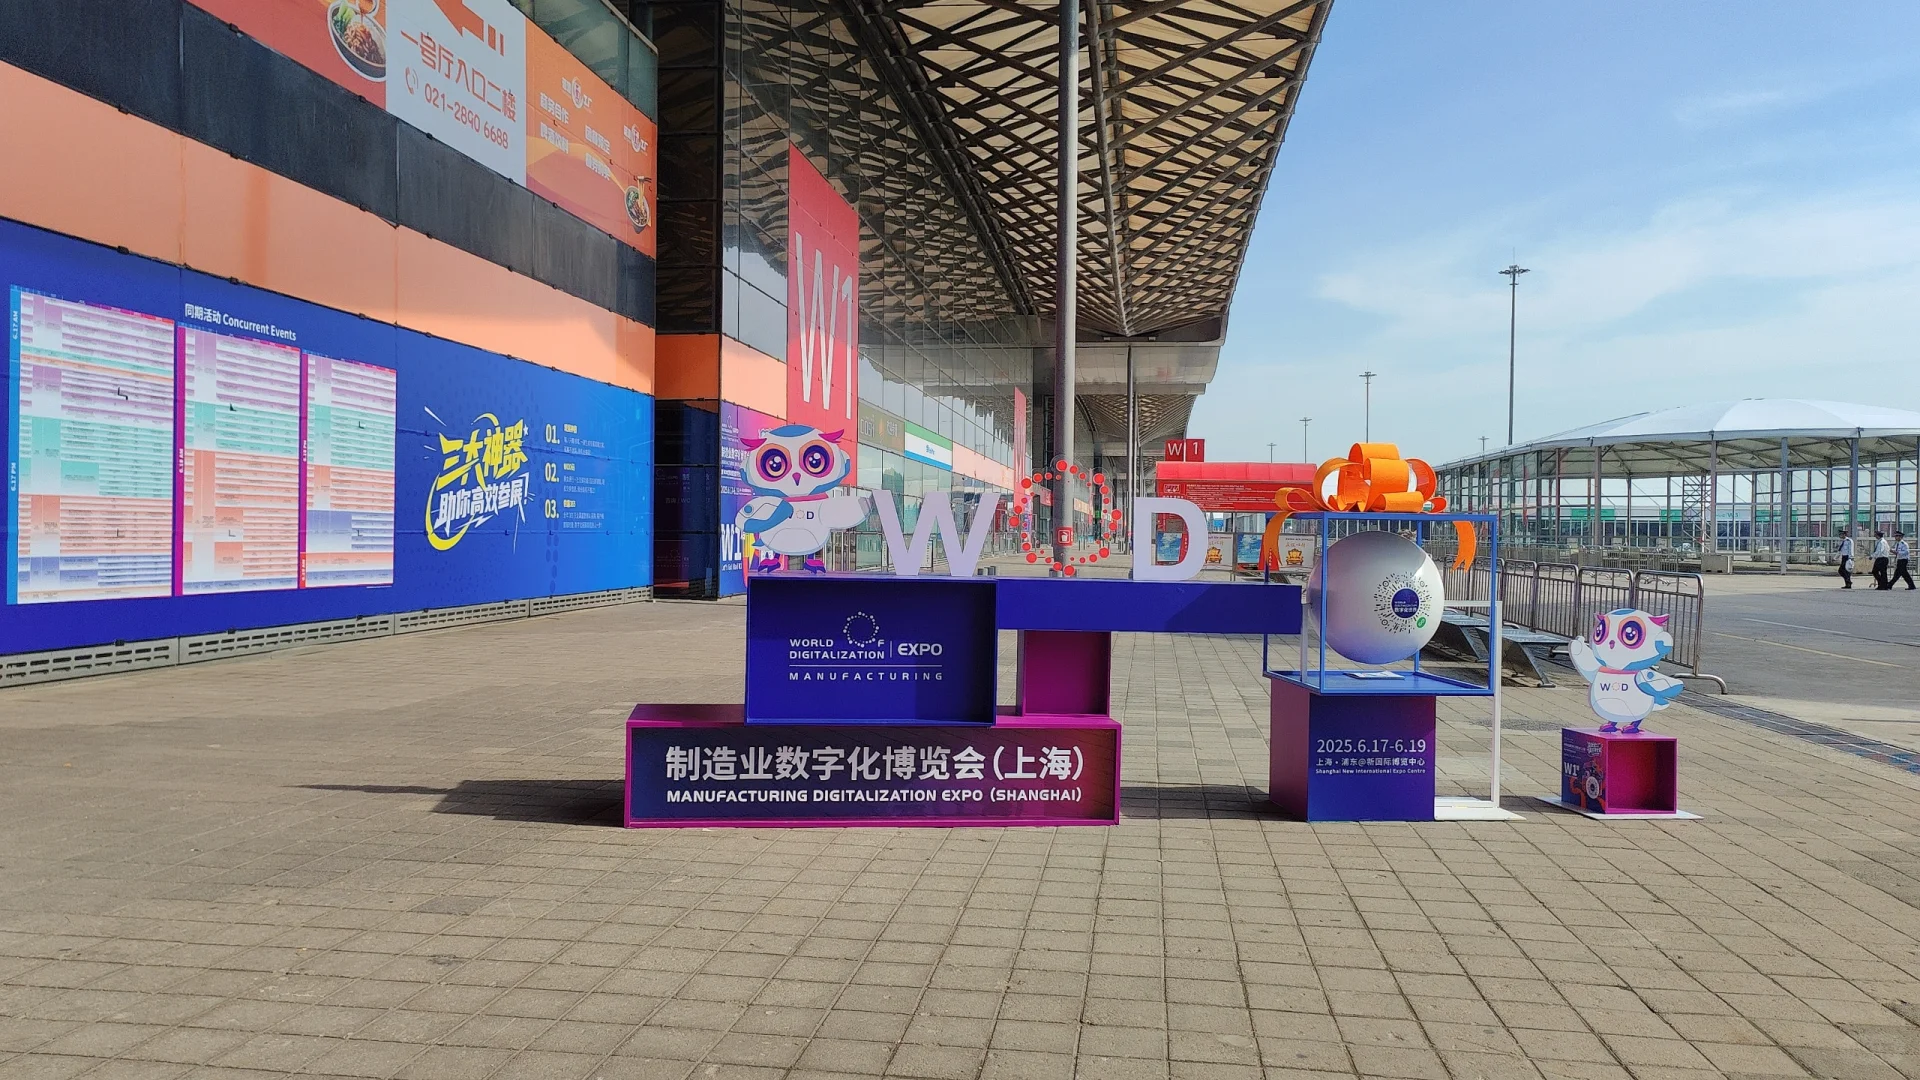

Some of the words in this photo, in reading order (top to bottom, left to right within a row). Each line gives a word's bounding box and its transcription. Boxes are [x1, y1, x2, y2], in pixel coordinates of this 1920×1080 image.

[400, 30, 516, 123] 一号厅入口二楼
[424, 83, 480, 133] 021-2890
[484, 121, 509, 150] 6688
[185, 303, 221, 325] 同期活动
[222, 313, 270, 336] Concurrent
[270, 324, 297, 342] Events
[795, 232, 852, 420] W1
[545, 423, 560, 445] 01.
[436, 418, 528, 491] 三大神器
[1167, 442, 1182, 456] W
[545, 463, 560, 483] 02.
[545, 499, 560, 519] 03.
[789, 638, 834, 648] WORLD
[897, 642, 943, 656] EXPO
[789, 650, 885, 660] DIGITALIZATION
[789, 672, 943, 681] MANUFACTURING
[1316, 739, 1427, 753] 2025.6.17-6.19
[666, 745, 1084, 781] 制造业数字化博览会（上海）
[666, 790, 808, 802] MANUFACTURING
[812, 789, 936, 802] DIGITALIZATION
[941, 789, 983, 802] EXPO
[990, 786, 1082, 802] (SHANGHAI)
